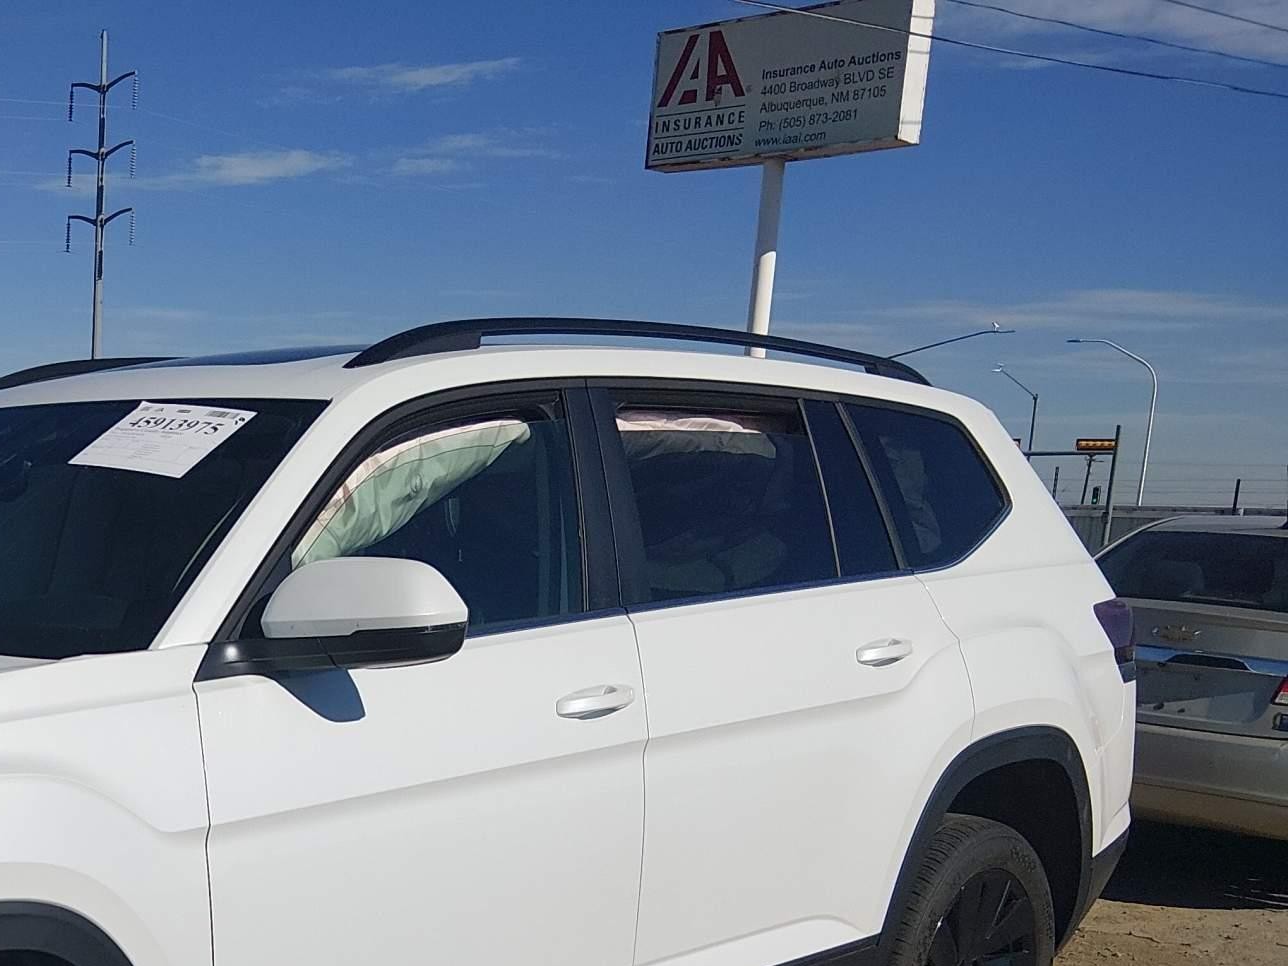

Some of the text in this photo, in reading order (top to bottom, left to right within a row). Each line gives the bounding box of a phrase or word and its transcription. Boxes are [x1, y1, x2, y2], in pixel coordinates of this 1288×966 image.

[762, 50, 902, 81] Insurance Auto Auctions
[760, 83, 787, 97] 4400
[789, 76, 840, 93] Broadway
[843, 69, 875, 85] BLVD
[878, 66, 895, 80] SE
[759, 85, 887, 114] Albuquerque, NM 87105
[654, 111, 745, 134] INSURANCE
[758, 109, 858, 132] Ph: (505) 873-2081
[652, 133, 743, 156] AUTO AUCTIONS
[754, 131, 826, 147] www.iaai.com
[128, 416, 225, 435] 45913975
